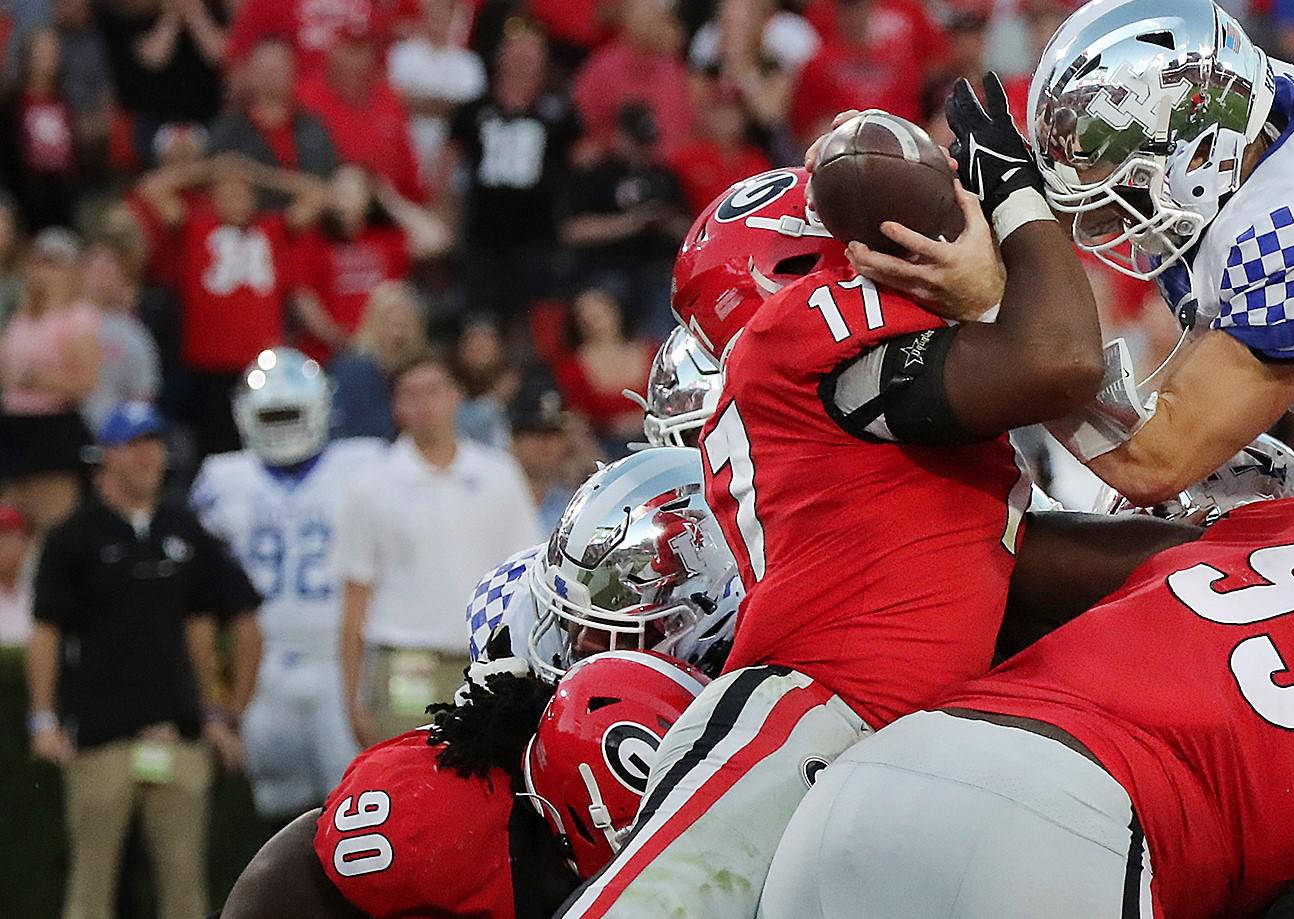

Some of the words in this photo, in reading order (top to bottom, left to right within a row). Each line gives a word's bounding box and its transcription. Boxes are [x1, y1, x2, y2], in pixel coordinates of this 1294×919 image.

[807, 273, 886, 344] 17
[250, 520, 333, 601] 92
[333, 789, 394, 878] 90
